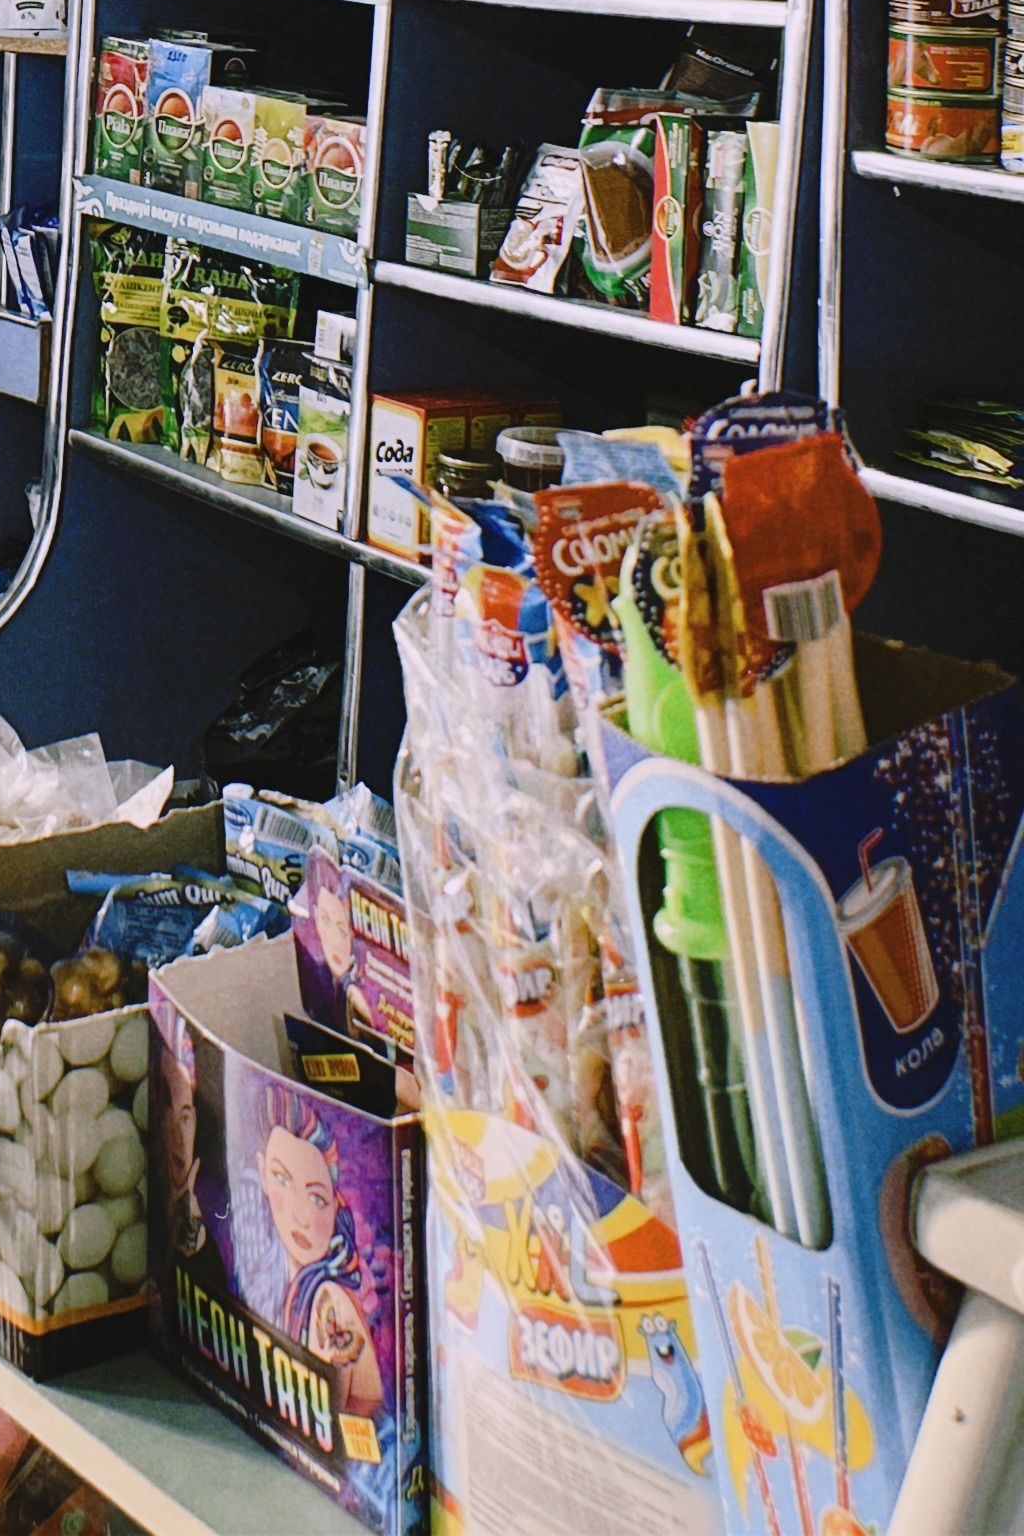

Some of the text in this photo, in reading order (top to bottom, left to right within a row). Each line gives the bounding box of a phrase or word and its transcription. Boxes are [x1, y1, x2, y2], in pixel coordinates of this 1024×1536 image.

[106, 114, 131, 136] Piala
[176, 1265, 250, 1390] НЕОН
[252, 1325, 333, 1453] ТАТУ
[519, 1314, 620, 1382] ЗЕФИР
